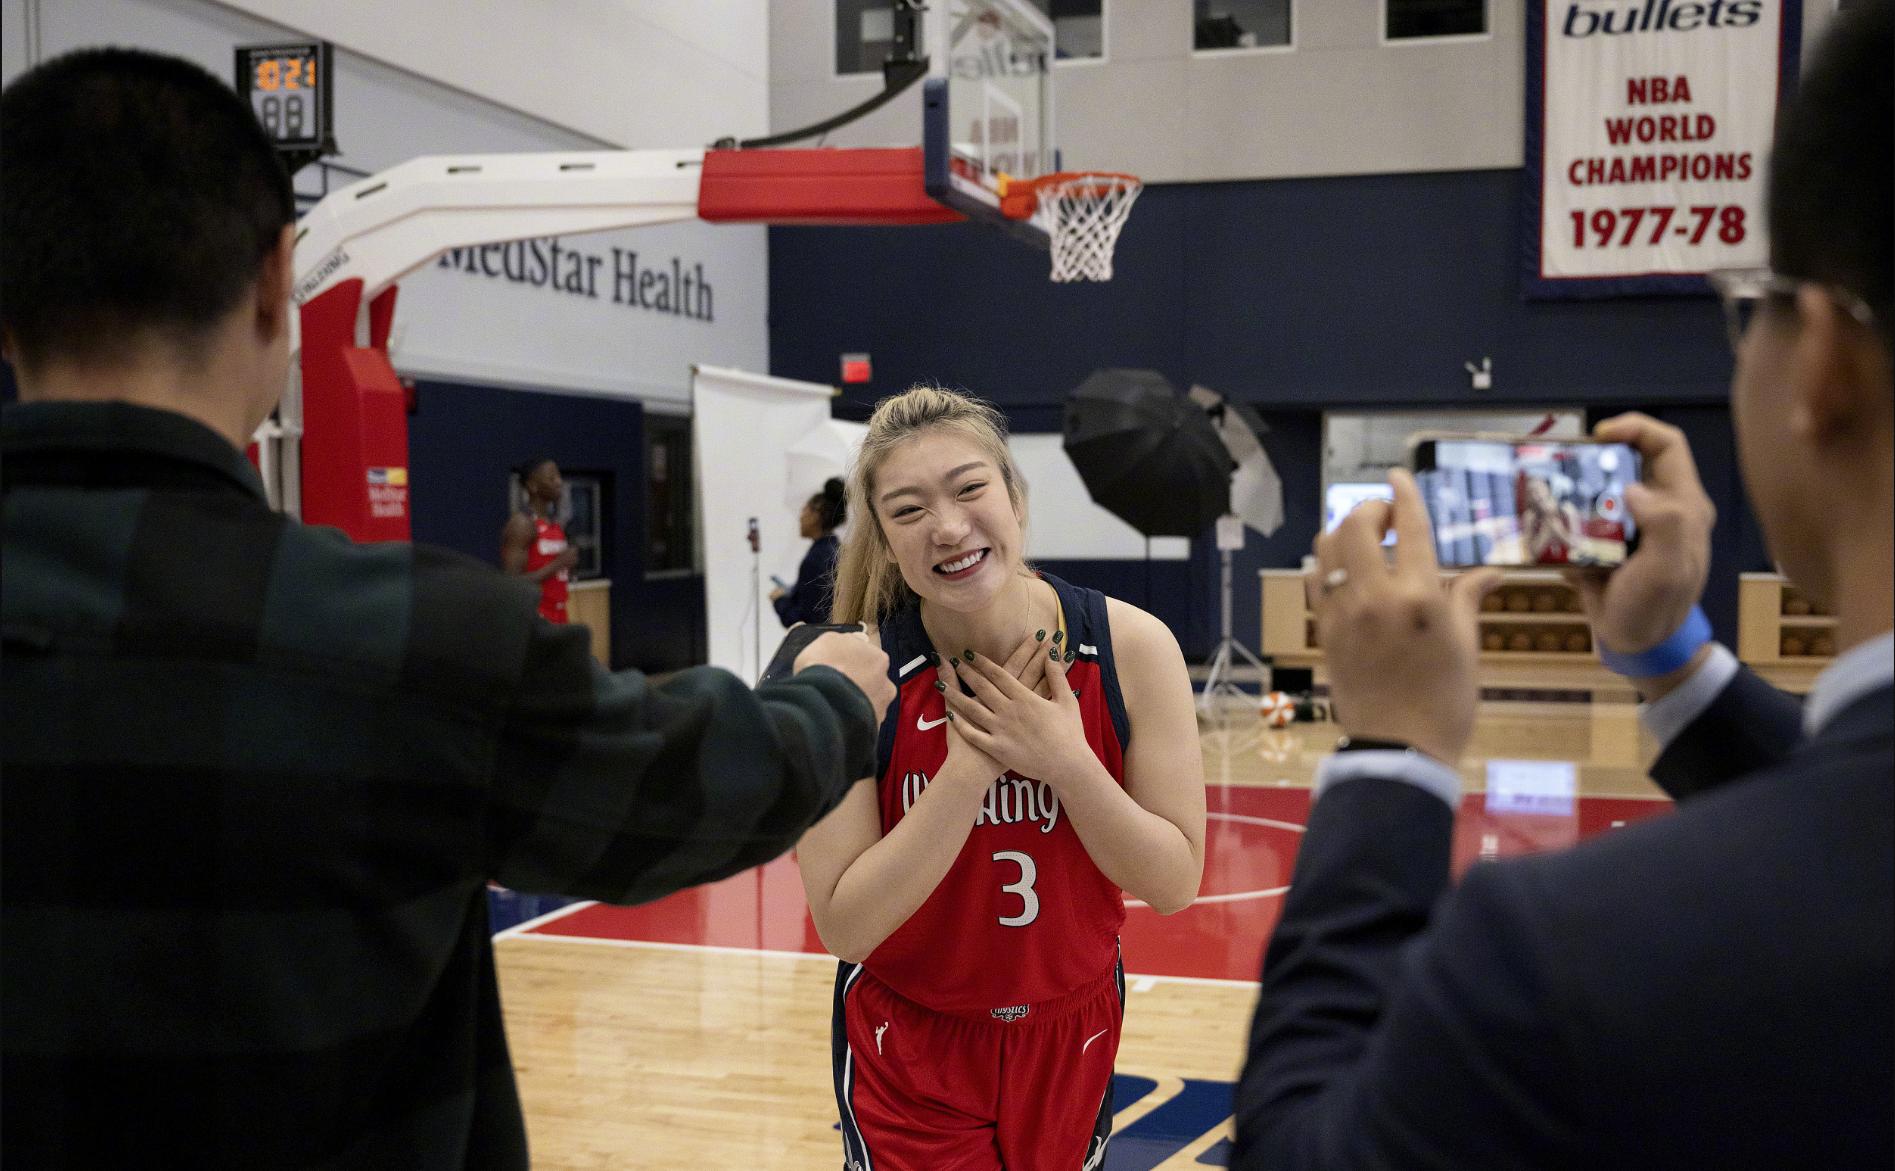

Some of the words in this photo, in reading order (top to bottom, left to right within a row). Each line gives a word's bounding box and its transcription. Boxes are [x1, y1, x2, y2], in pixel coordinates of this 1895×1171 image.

[1564, 0, 1763, 38] bullets
[1627, 75, 1692, 105] NBA
[1605, 114, 1716, 145] WORLD
[1568, 153, 1752, 186] CHAMPIONS
[1570, 205, 1747, 249] 1977-78
[612, 246, 714, 322] Health
[991, 850, 1040, 928] 3
